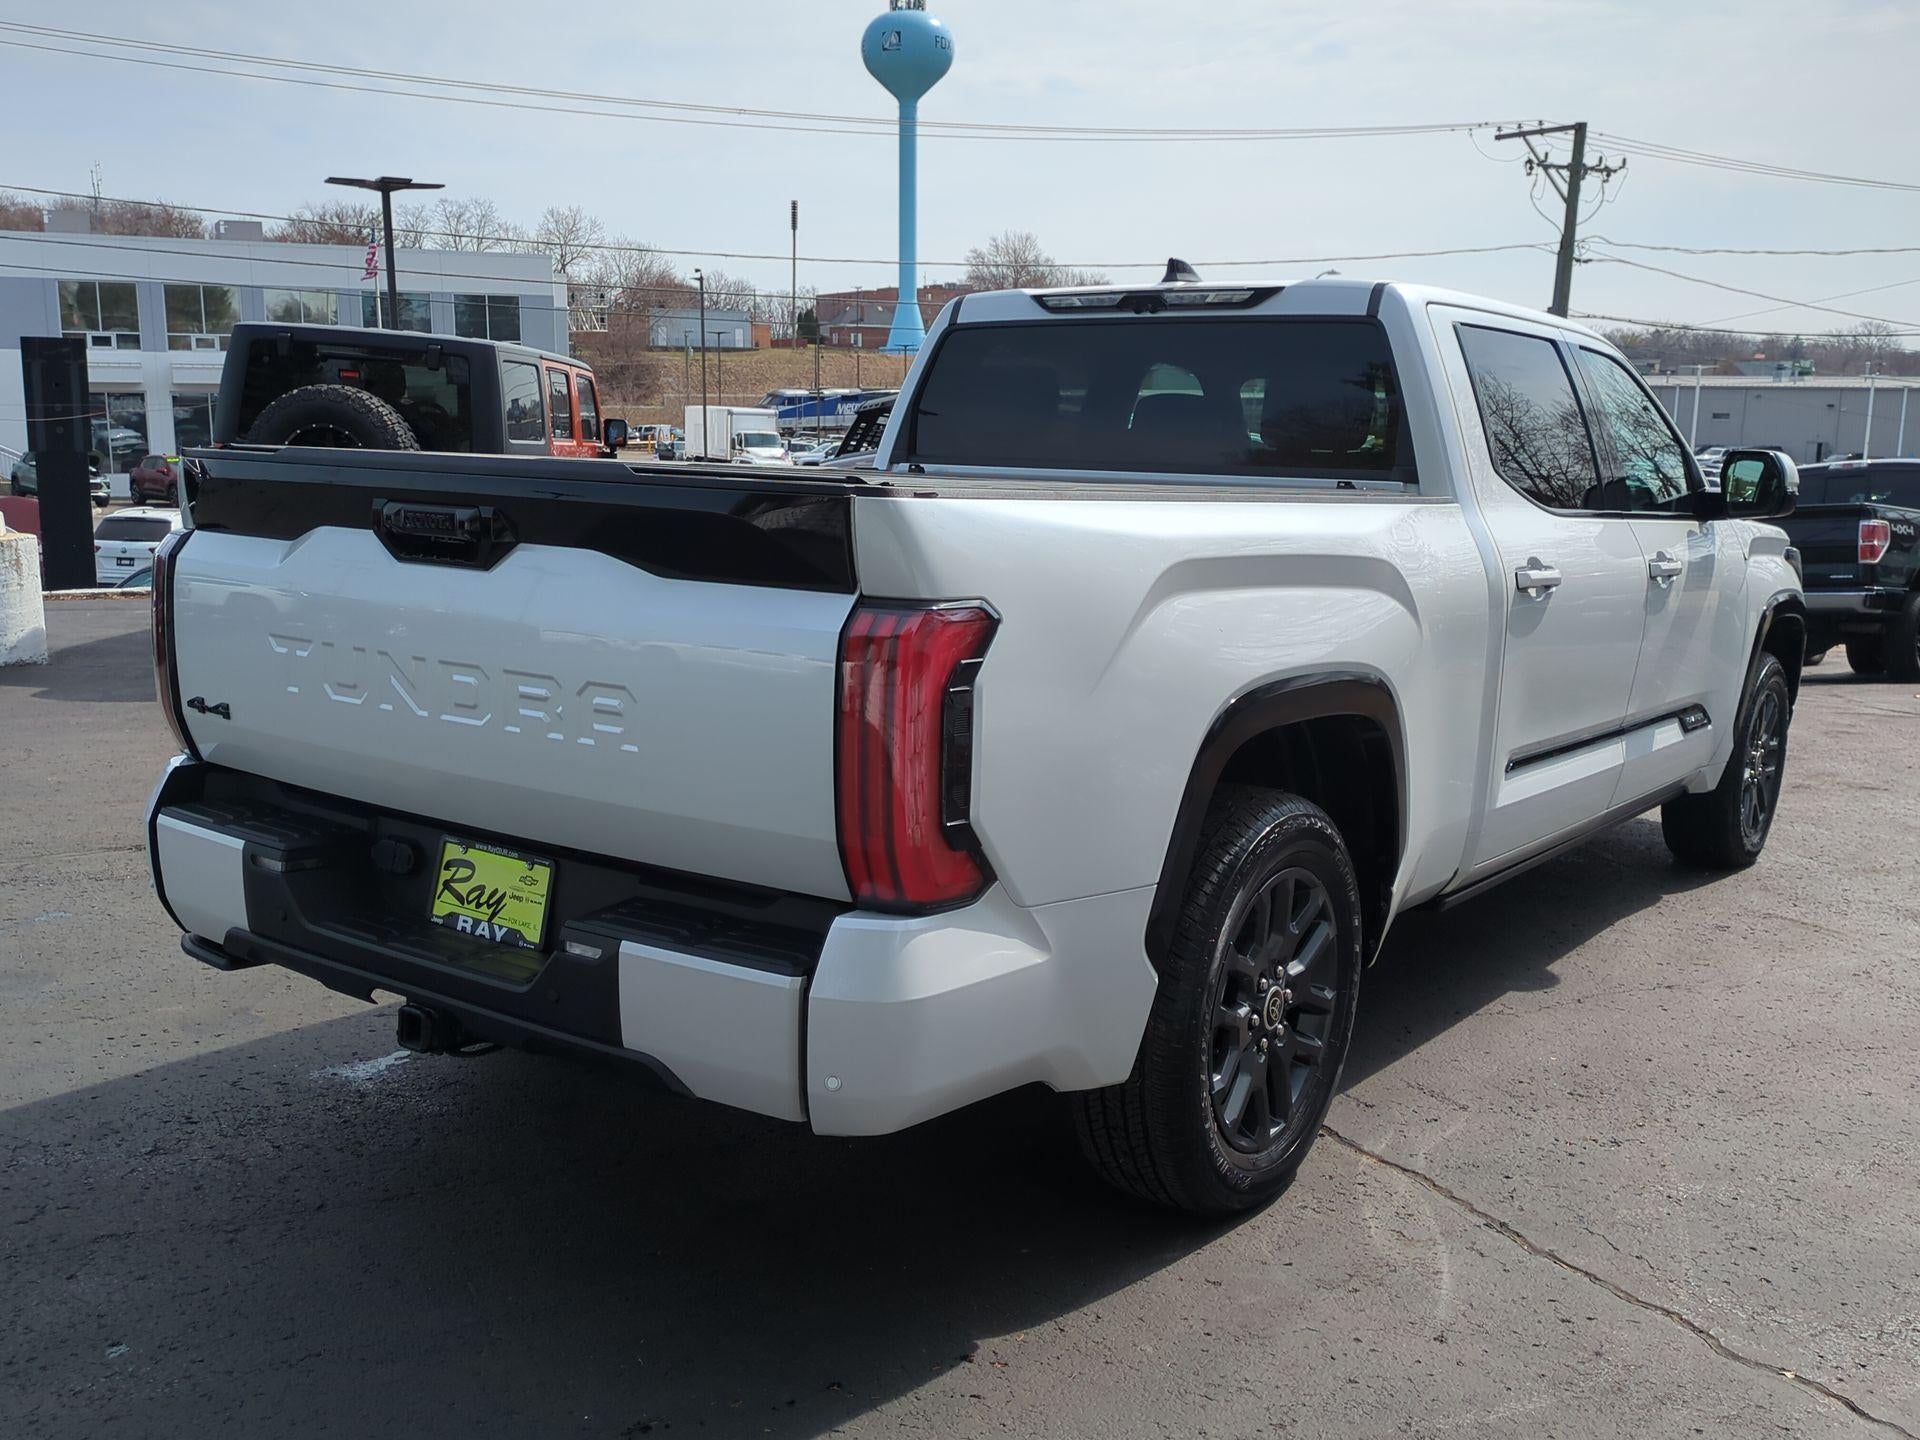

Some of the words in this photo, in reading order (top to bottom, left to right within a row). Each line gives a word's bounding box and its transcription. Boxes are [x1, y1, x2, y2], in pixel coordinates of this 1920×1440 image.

[268, 632, 640, 753] TUNDRA
[437, 858, 507, 922] Ray
[457, 915, 508, 942] RAY
